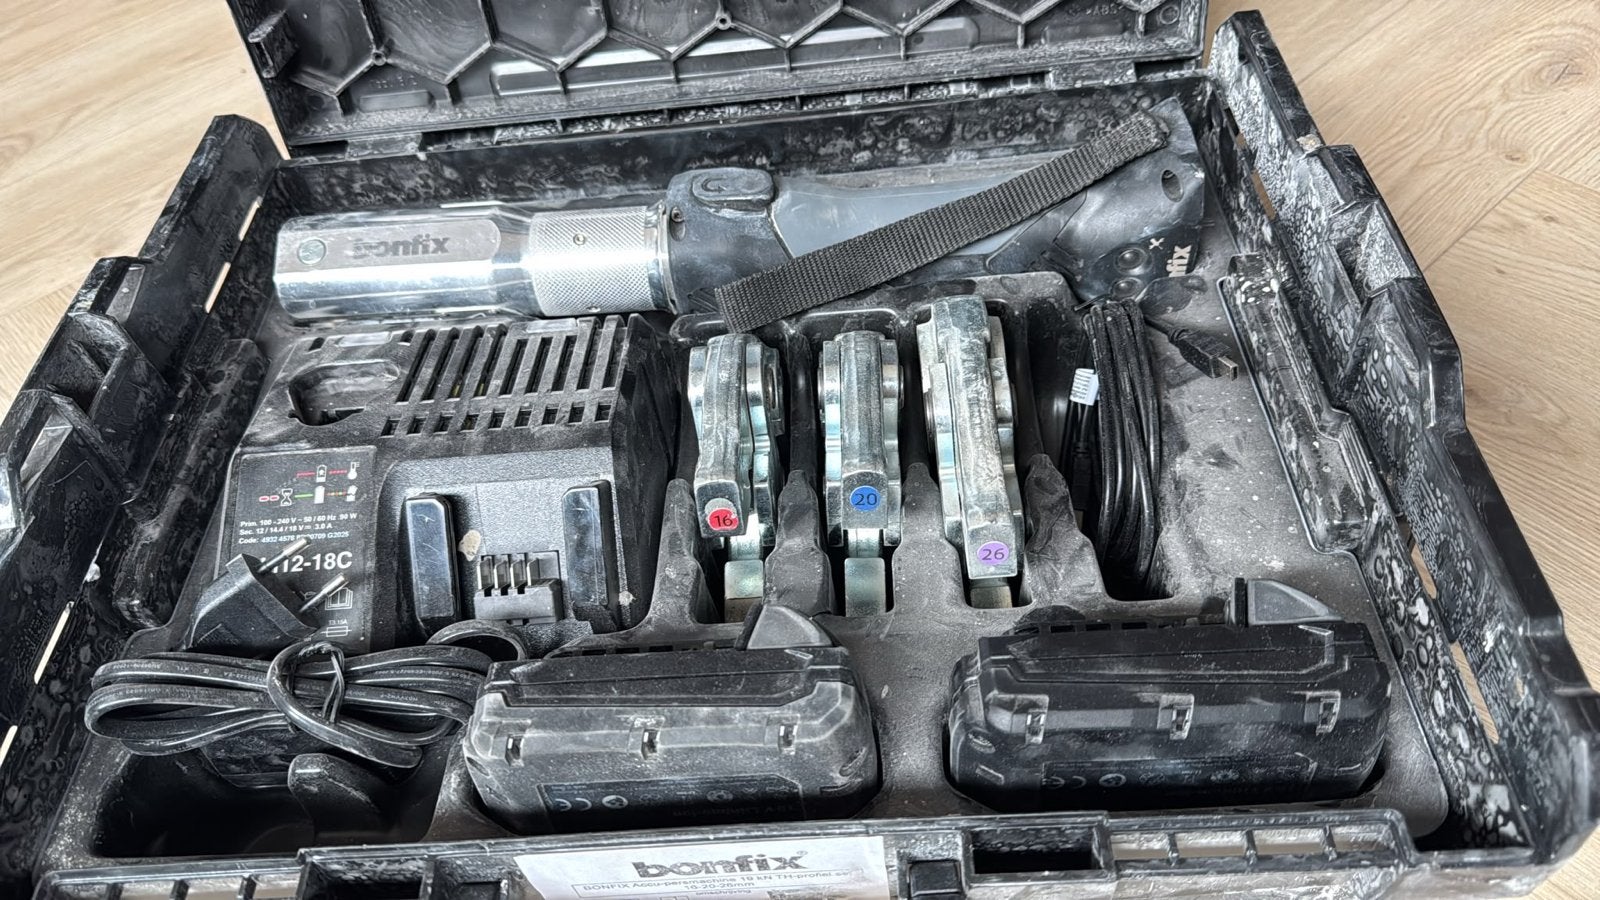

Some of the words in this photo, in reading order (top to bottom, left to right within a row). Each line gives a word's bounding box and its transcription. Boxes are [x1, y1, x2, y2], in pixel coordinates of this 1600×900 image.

[854, 493, 878, 507] 20
[713, 515, 733, 528] 16
[981, 548, 1005, 561] 26
[261, 551, 353, 573] 12-18C
[583, 883, 630, 891] BONFIX
